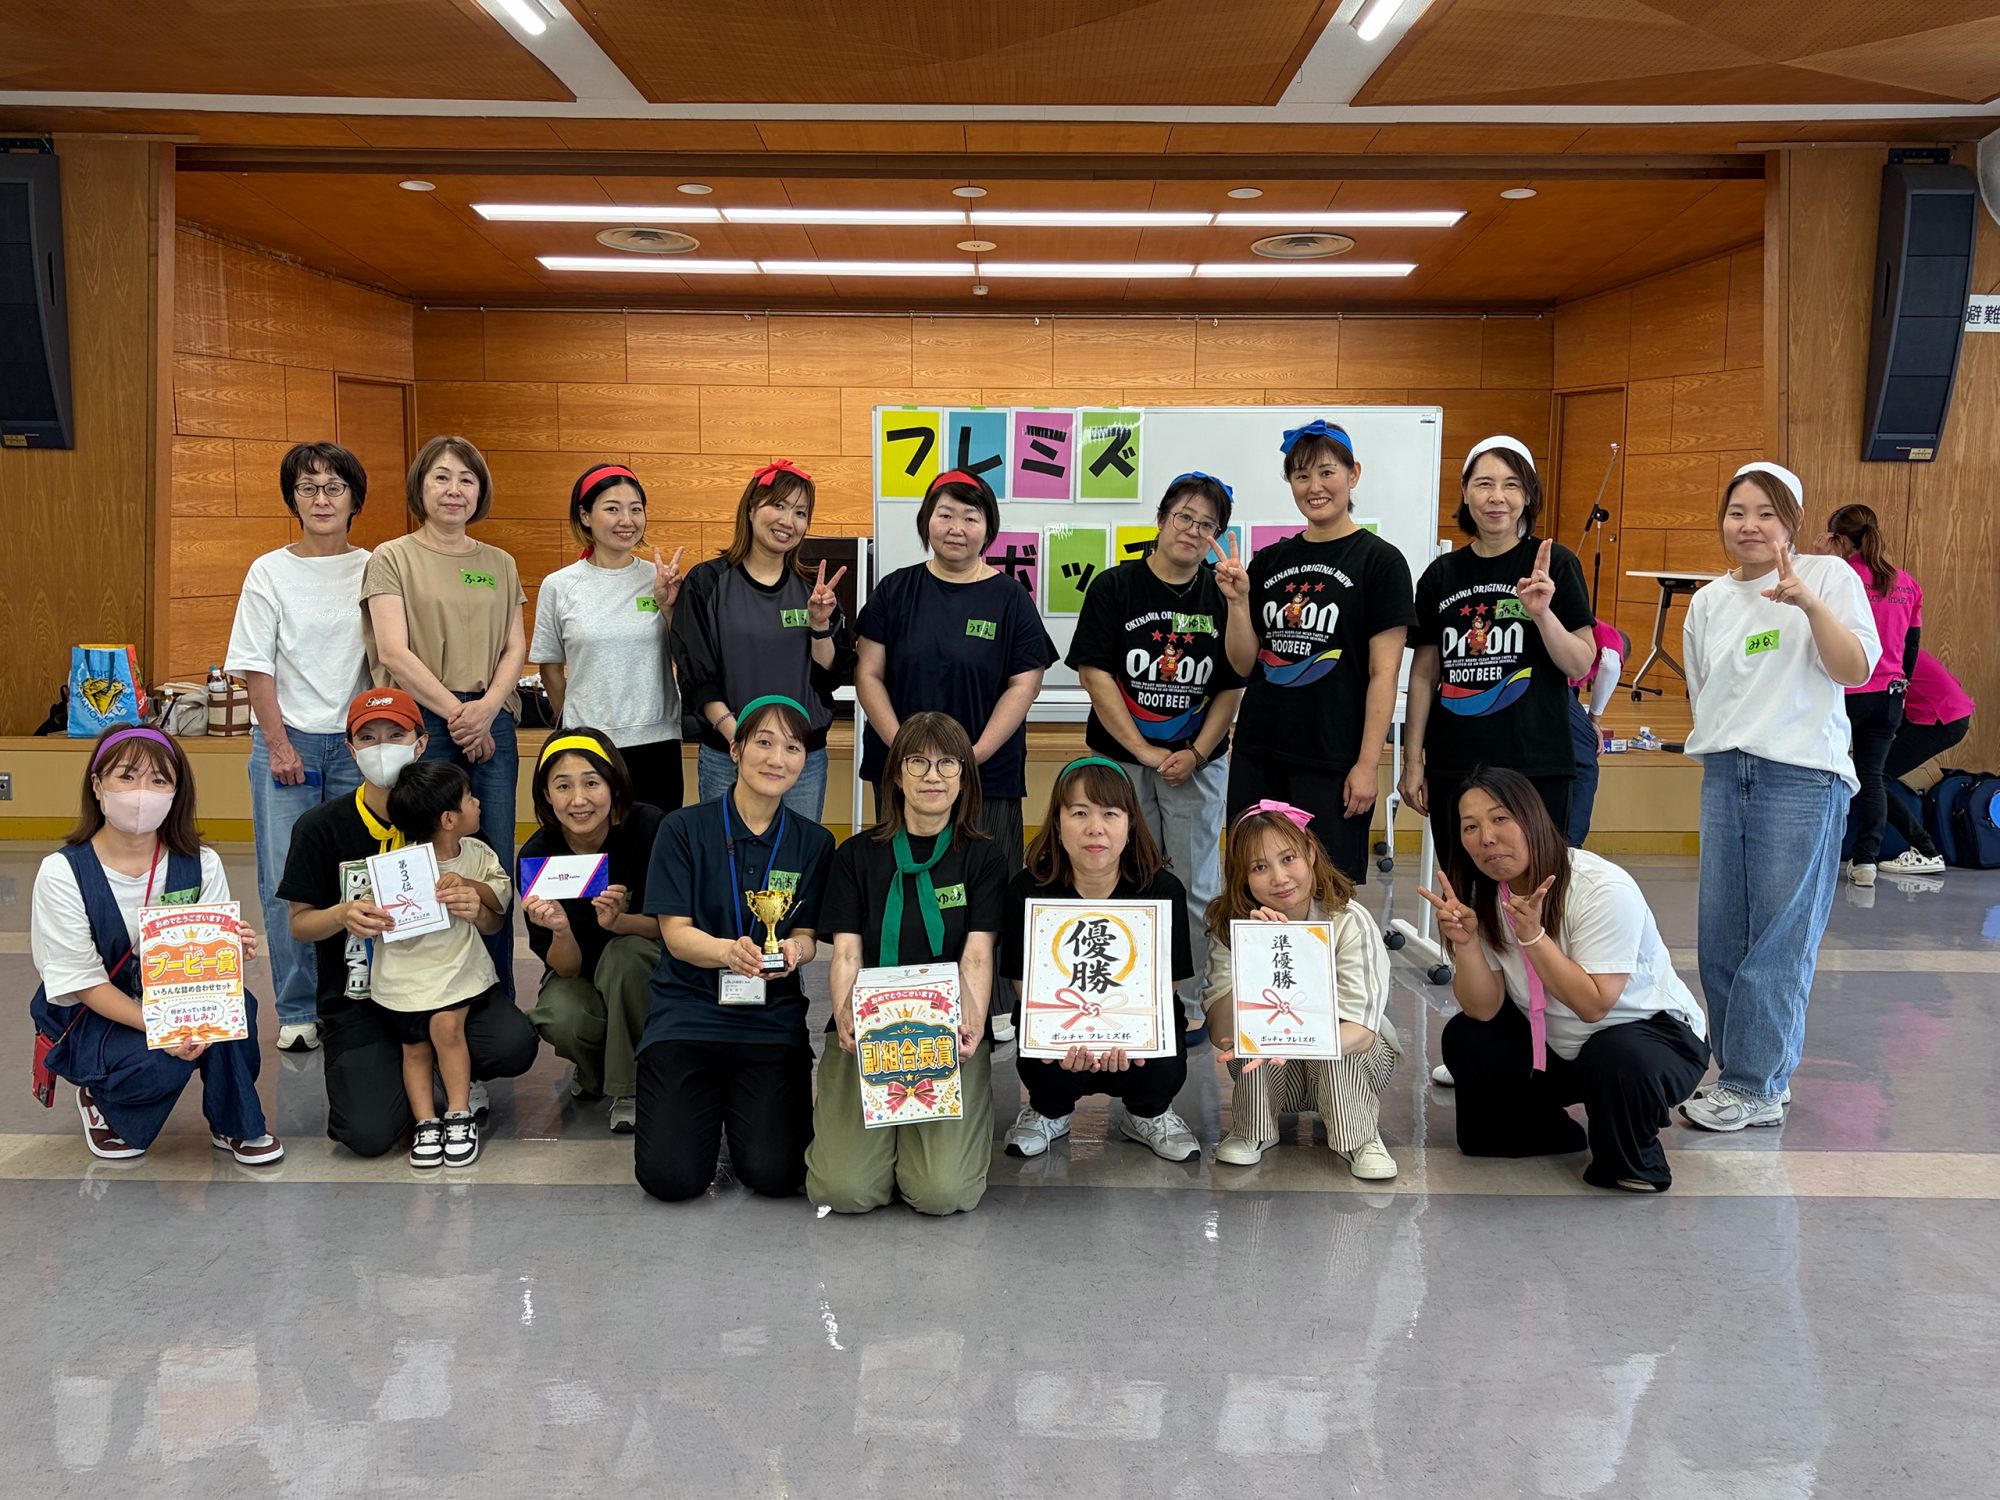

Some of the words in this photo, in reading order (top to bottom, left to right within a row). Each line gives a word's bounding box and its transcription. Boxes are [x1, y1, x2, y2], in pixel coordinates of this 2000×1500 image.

[1965, 305, 2000, 325] 避難
[886, 425, 1136, 478] フレミズ
[1263, 566, 1300, 590] OKINAWA
[1472, 583, 1511, 594] ORIGINAL
[1125, 611, 1160, 632] OKINAWA
[1262, 600, 1340, 634] Oron
[1442, 621, 1525, 659] Oron
[1126, 648, 1214, 684] Oron
[1449, 668, 1476, 684] ROOT
[1476, 666, 1503, 682] BEER
[75, 691, 108, 728] DIAMOND
[1138, 691, 1165, 707] ROOT
[1165, 695, 1190, 709] BEER
[398, 859, 414, 892] 第3位
[154, 916, 226, 929] おめでとうございます!
[147, 947, 238, 980] ブービー賞
[1062, 918, 1124, 994] 優勝
[1270, 934, 1298, 990] 準優勝
[153, 982, 232, 996] いろんな詰め合わせセット
[870, 992, 938, 1004] おめでとうございます!
[1051, 1032, 1084, 1041] ボッチャ
[860, 1035, 956, 1076] 副組合長賞
